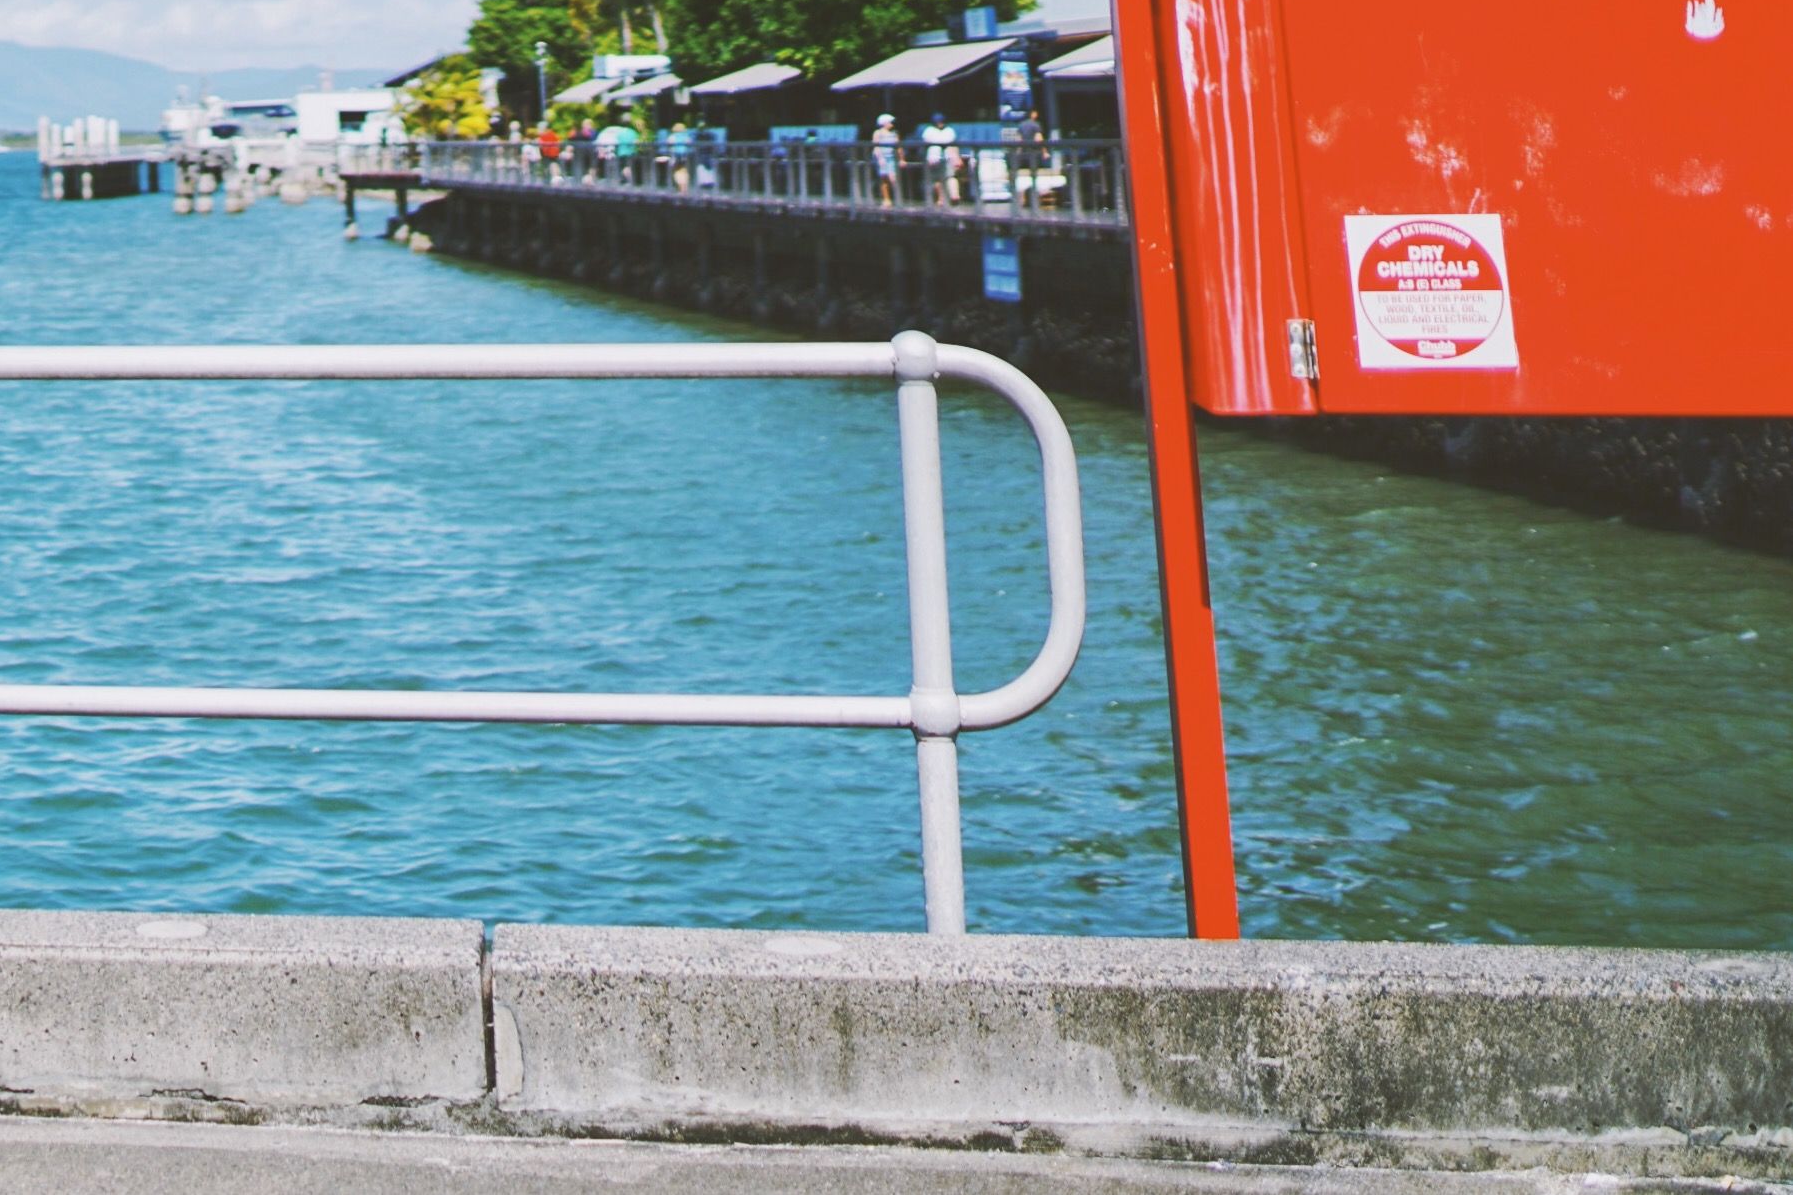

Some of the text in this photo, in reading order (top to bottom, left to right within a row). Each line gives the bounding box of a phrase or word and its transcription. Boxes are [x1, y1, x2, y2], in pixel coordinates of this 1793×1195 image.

[1408, 245, 1444, 261] DRY
[1377, 260, 1480, 277] CHEMICALS
[1431, 279, 1462, 290] CLASS
[1377, 294, 1389, 303] TO
[1391, 294, 1403, 303] BE
[1406, 294, 1429, 303] USED
[1433, 294, 1451, 303] FOR
[1412, 315, 1431, 324] AND
[1434, 314, 1489, 324] ELECTRICAL
